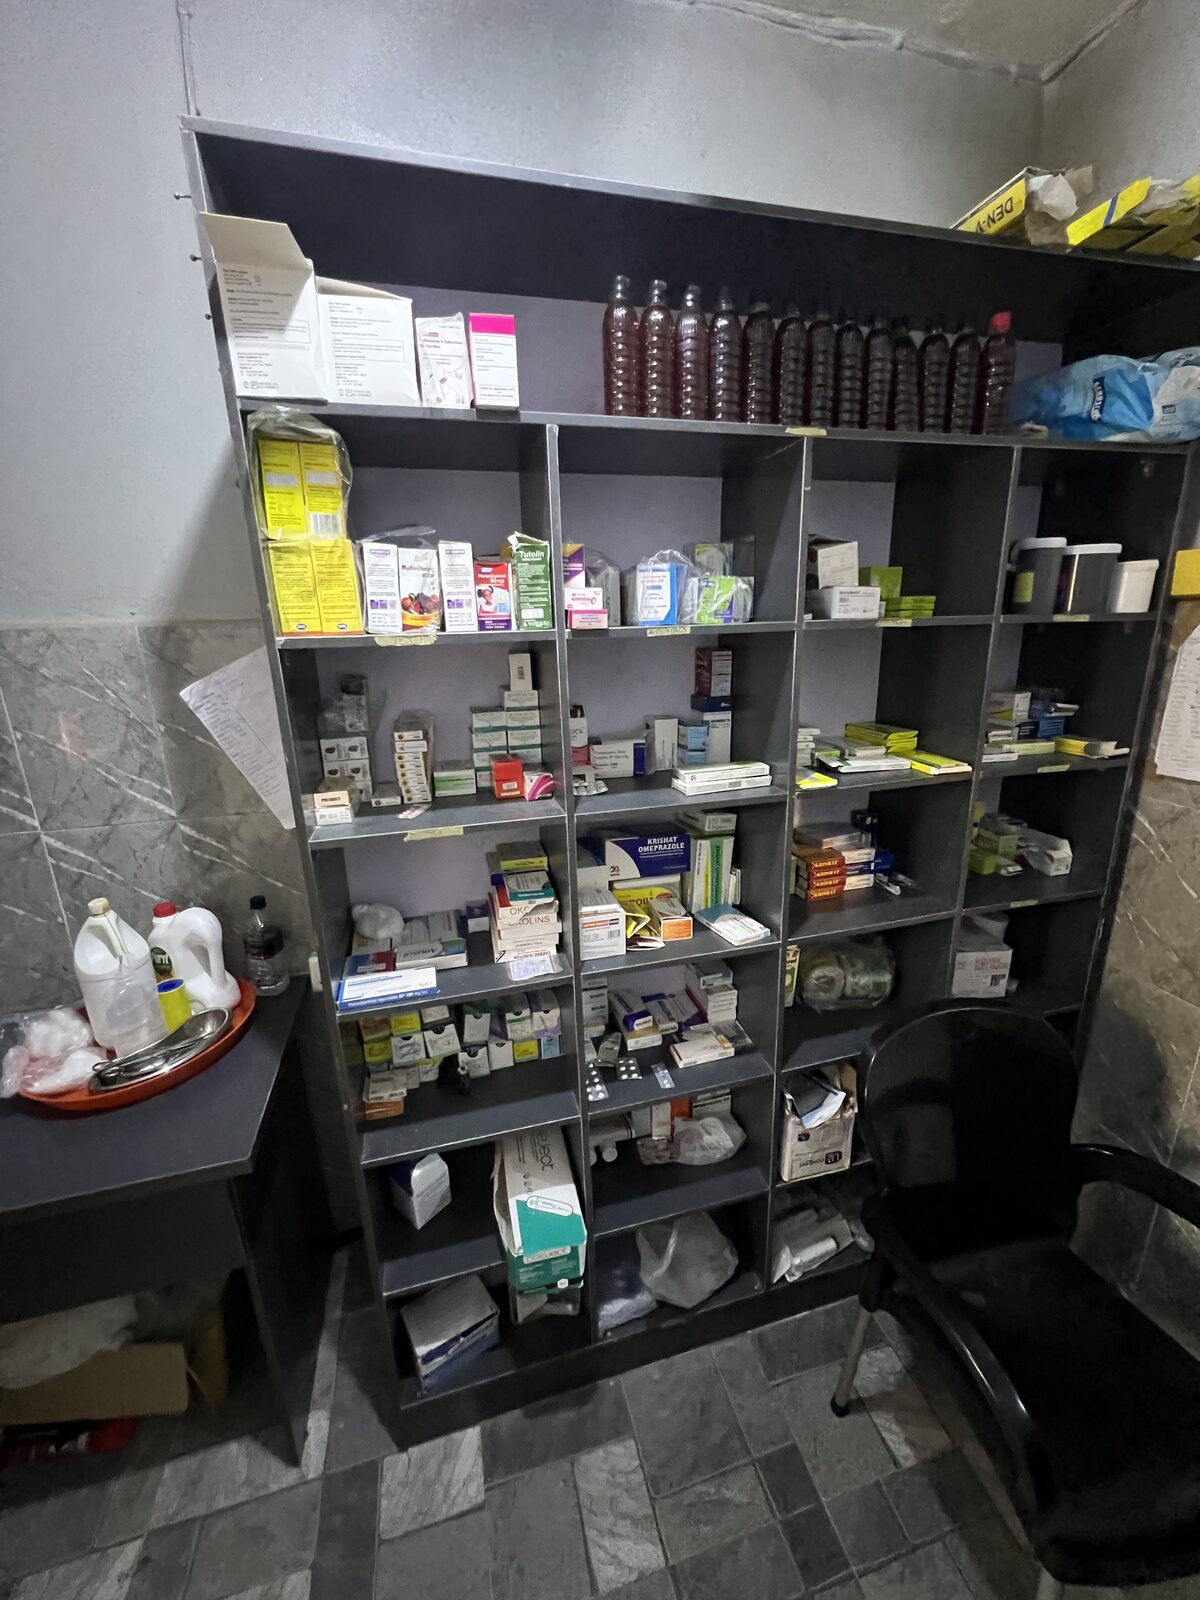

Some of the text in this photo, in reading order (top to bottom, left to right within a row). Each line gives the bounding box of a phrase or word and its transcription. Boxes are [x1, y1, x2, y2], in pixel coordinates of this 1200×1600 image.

[519, 550, 545, 559] Tutolin
[647, 836, 678, 845] KRISHAT
[638, 842, 685, 853] OMEPRAZOLE
